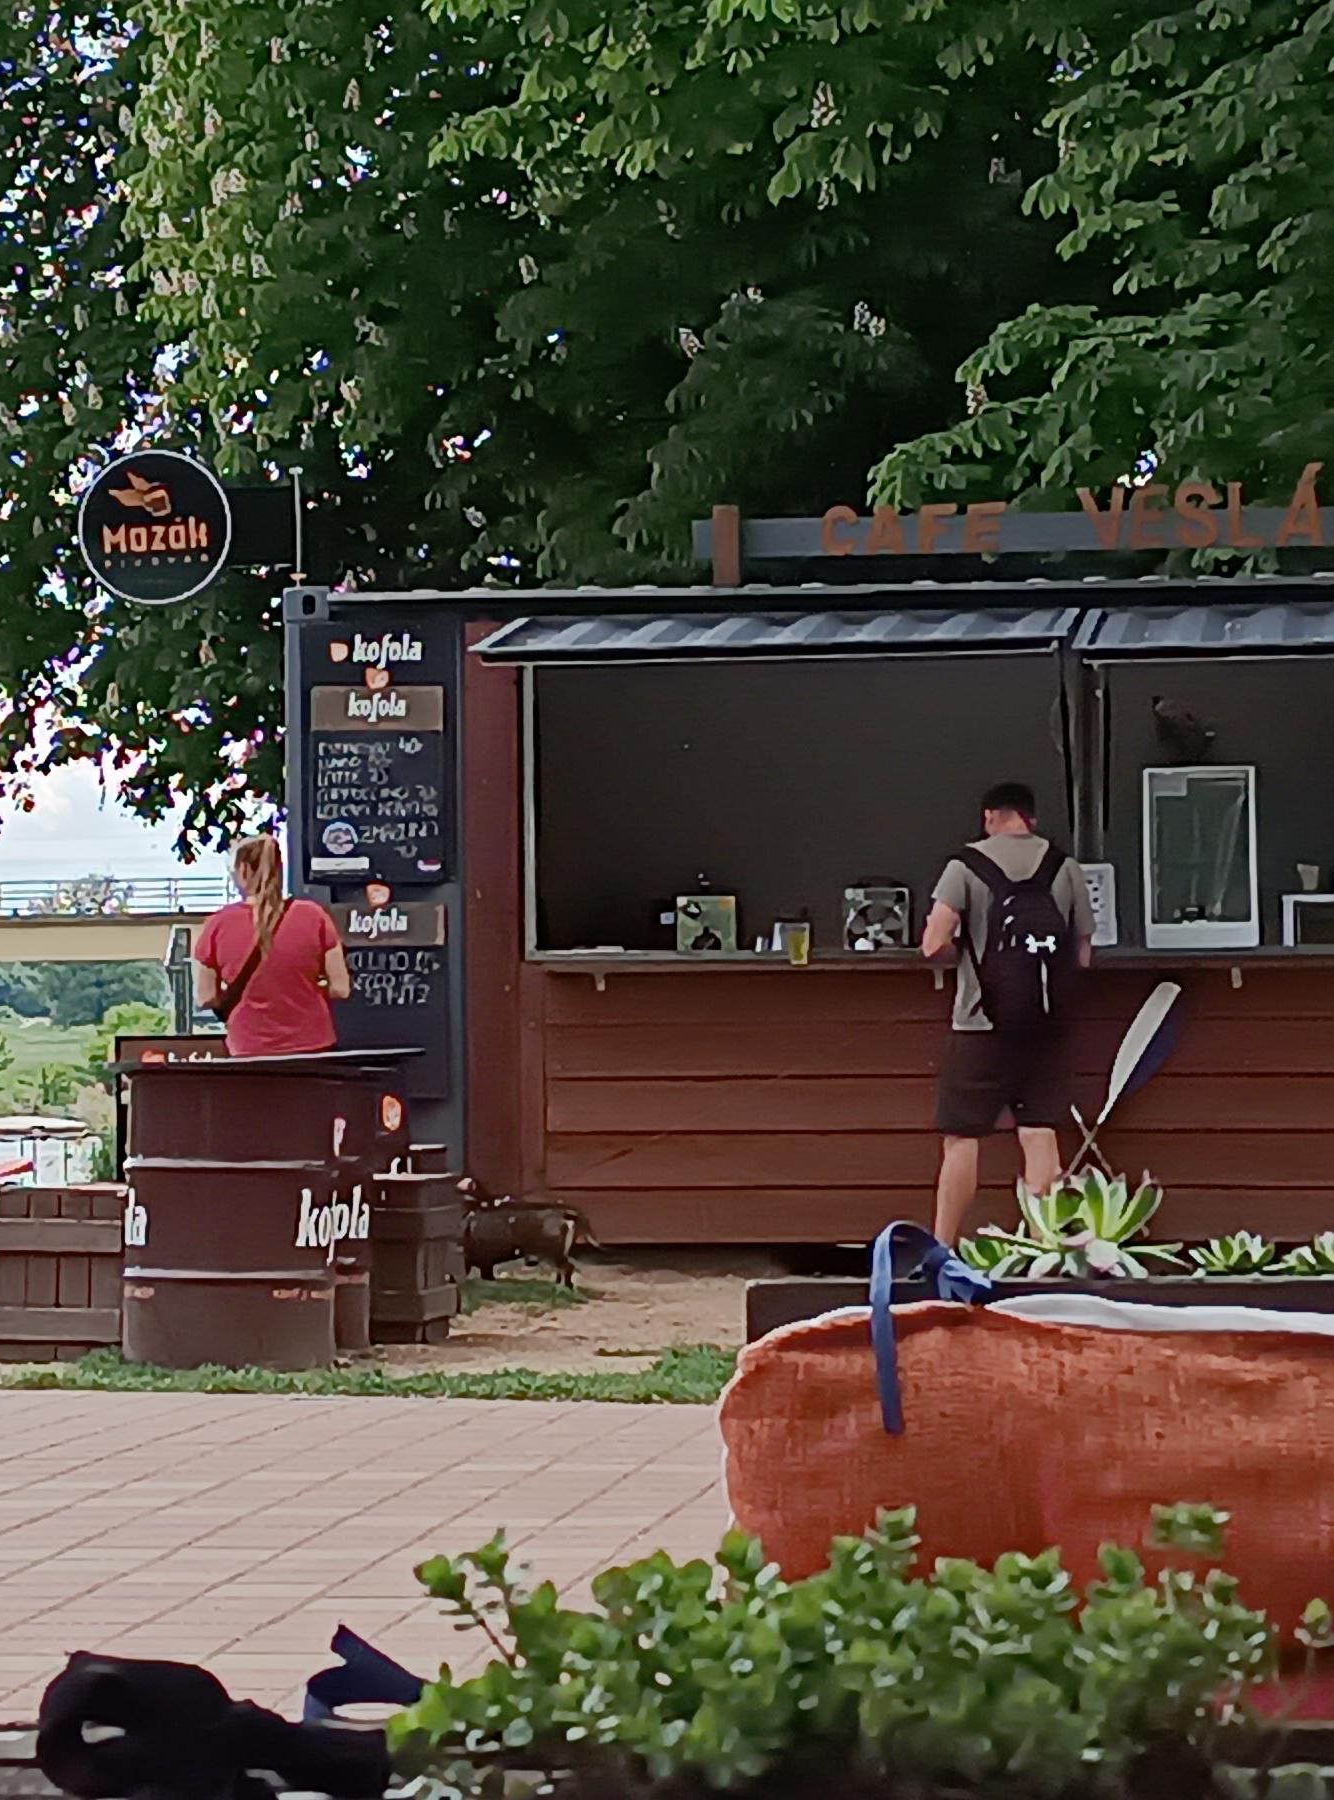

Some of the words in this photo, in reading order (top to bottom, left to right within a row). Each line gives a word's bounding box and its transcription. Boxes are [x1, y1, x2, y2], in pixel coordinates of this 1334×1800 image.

[821, 502, 1007, 555] CAFE
[352, 633, 422, 669] kofola
[348, 691, 406, 722] kofola
[349, 907, 408, 939] kofola
